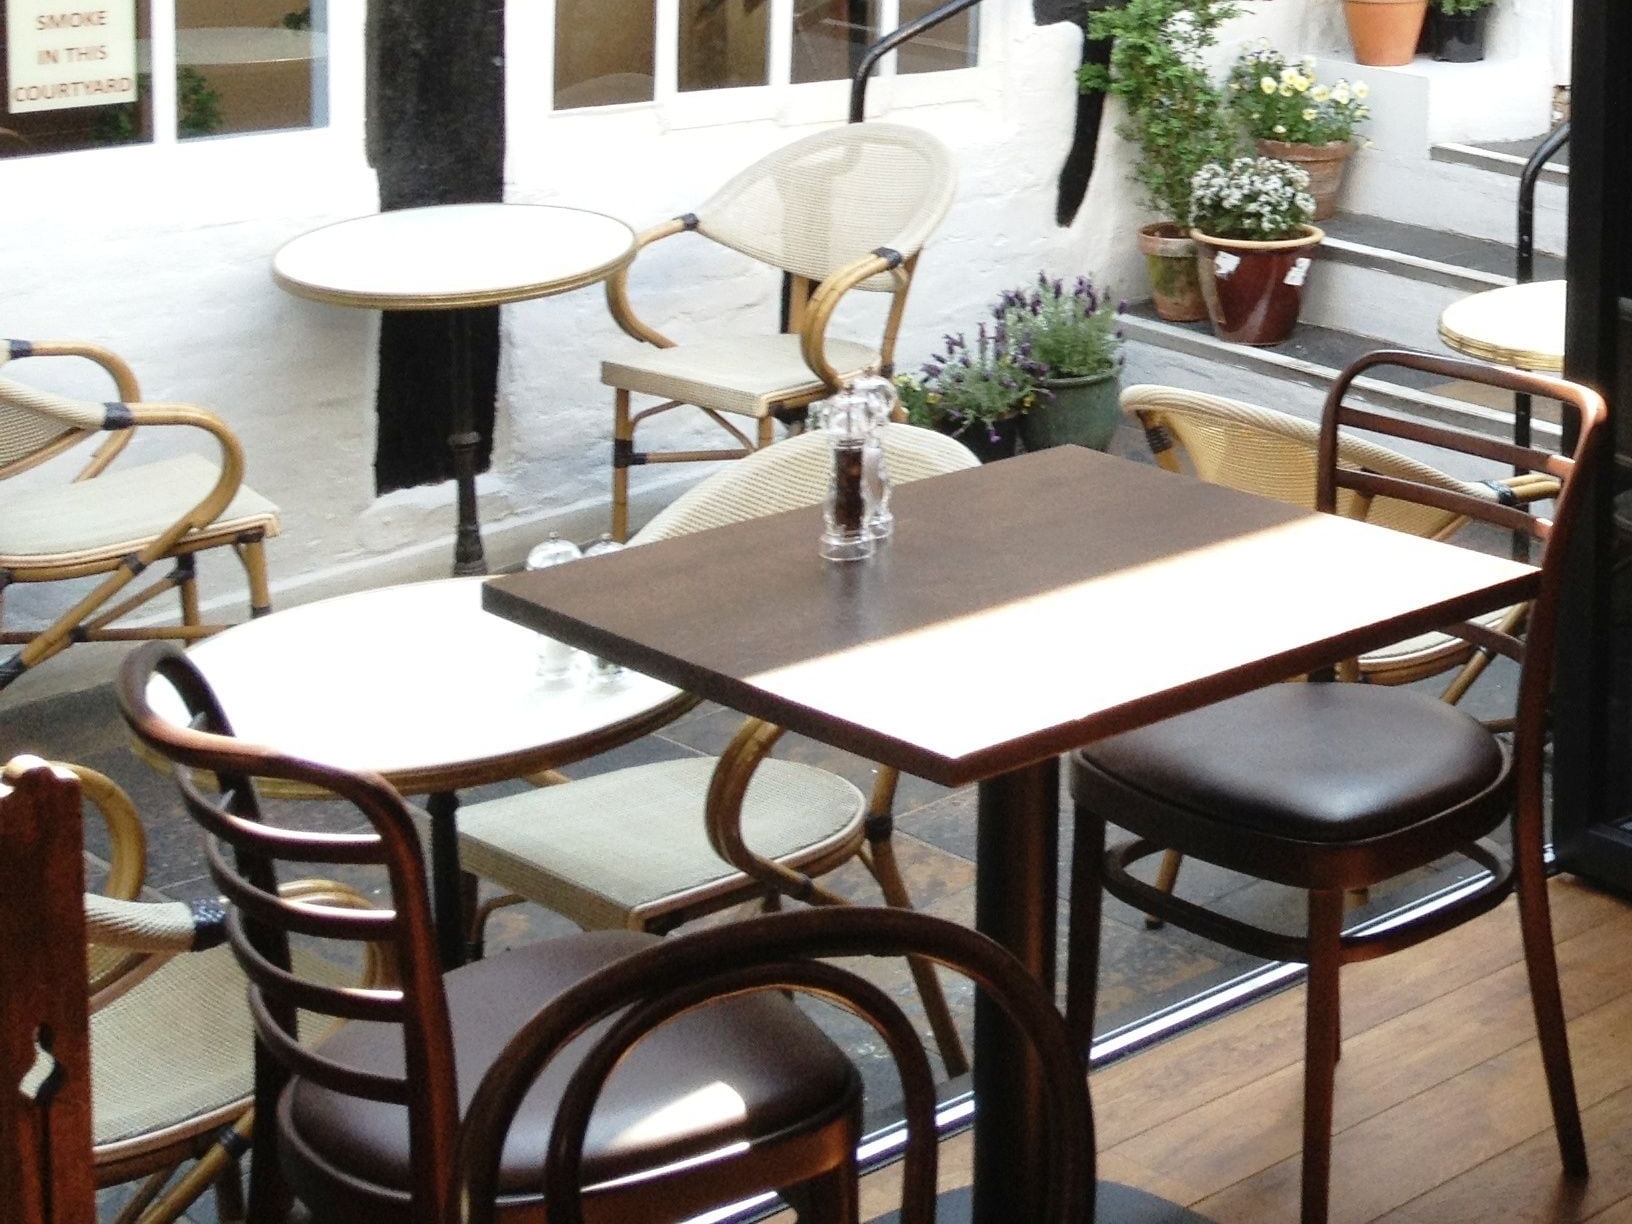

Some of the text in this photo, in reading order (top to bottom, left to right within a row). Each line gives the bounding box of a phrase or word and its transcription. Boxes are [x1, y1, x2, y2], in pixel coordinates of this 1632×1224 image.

[36, 10, 108, 30] SMOKE
[37, 45, 109, 65] IN THIS
[14, 77, 132, 102] COURTYARD
